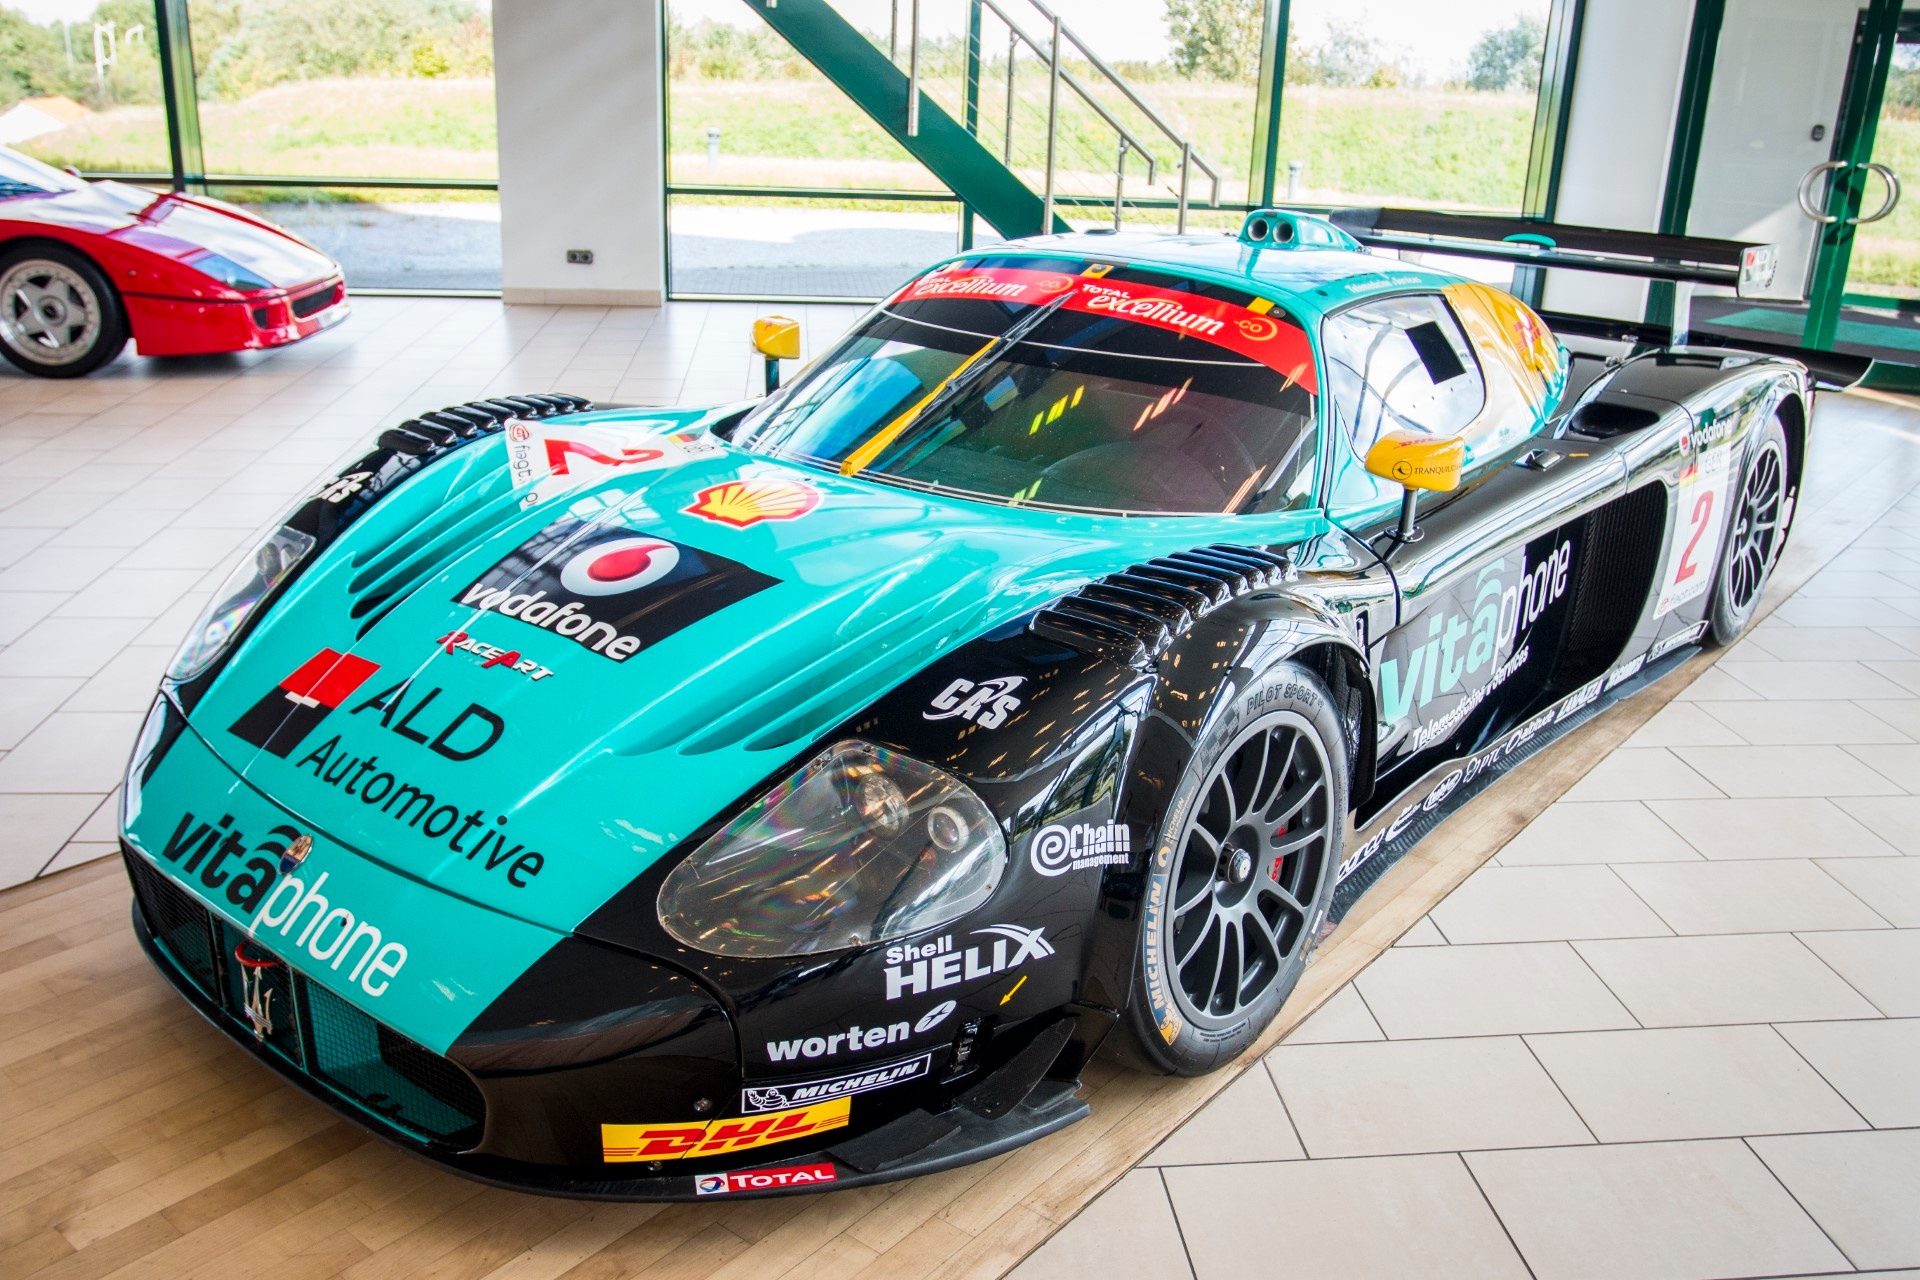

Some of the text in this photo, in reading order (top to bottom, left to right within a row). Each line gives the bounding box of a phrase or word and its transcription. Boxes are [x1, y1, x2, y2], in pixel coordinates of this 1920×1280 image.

[914, 278, 1028, 297] excellium
[1083, 284, 1131, 299] TOTAL
[1087, 295, 1224, 336] excellium
[1691, 419, 1731, 448] vodafone
[1674, 490, 1713, 586] 2
[461, 582, 641, 661] vodafone
[1380, 540, 1571, 728] vitaphone
[350, 677, 505, 762] ALD
[1247, 683, 1318, 715] PILOT SPORT
[296, 734, 545, 889] Automotive
[1164, 797, 1185, 843] MICHELIN
[1073, 853, 1130, 870] management
[1333, 828, 1386, 885] parco
[162, 812, 408, 998] vitaphone
[884, 924, 1055, 1000] HELIX
[886, 934, 952, 965] Shell
[1146, 881, 1165, 1010] MICHELIN
[766, 1017, 909, 1062] worten
[792, 1062, 920, 1100] MICHELIN
[638, 1111, 819, 1156] DHL
[730, 1169, 835, 1188] TOTAL
